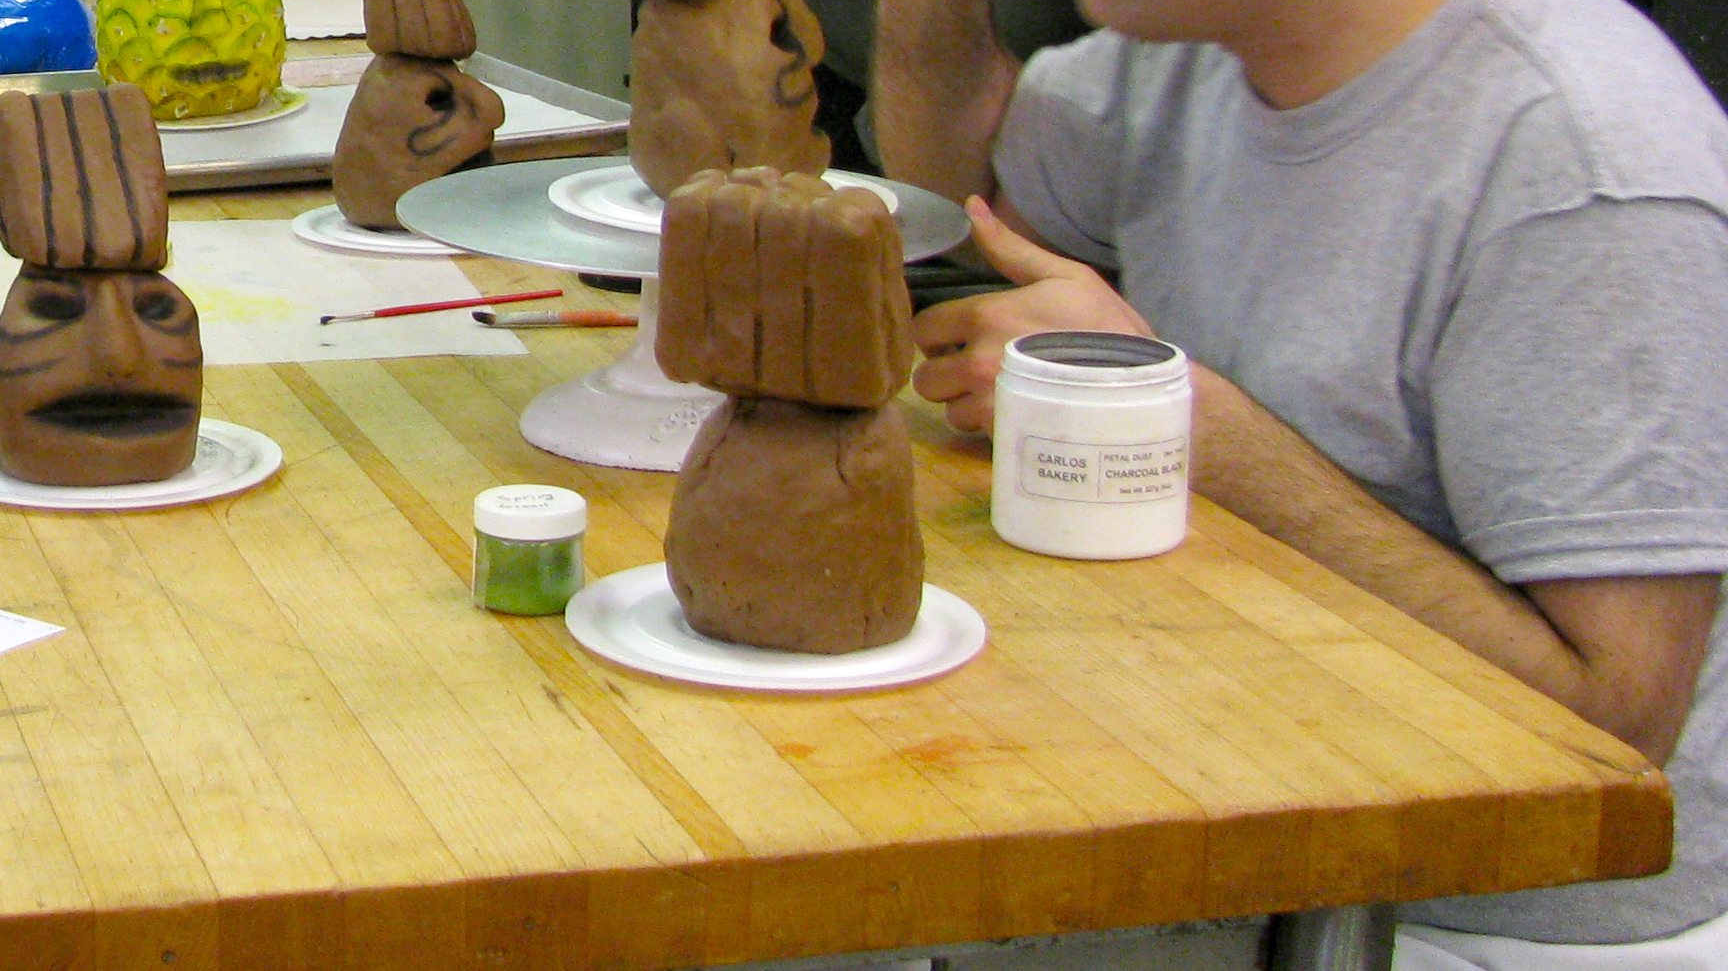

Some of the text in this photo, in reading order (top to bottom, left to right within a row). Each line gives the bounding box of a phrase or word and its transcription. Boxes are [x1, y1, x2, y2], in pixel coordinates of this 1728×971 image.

[1038, 453, 1087, 469] CARLOS
[1103, 454, 1130, 462] PETAL
[1038, 467, 1087, 483] BAKERY
[1105, 467, 1159, 479] CHARCOAL
